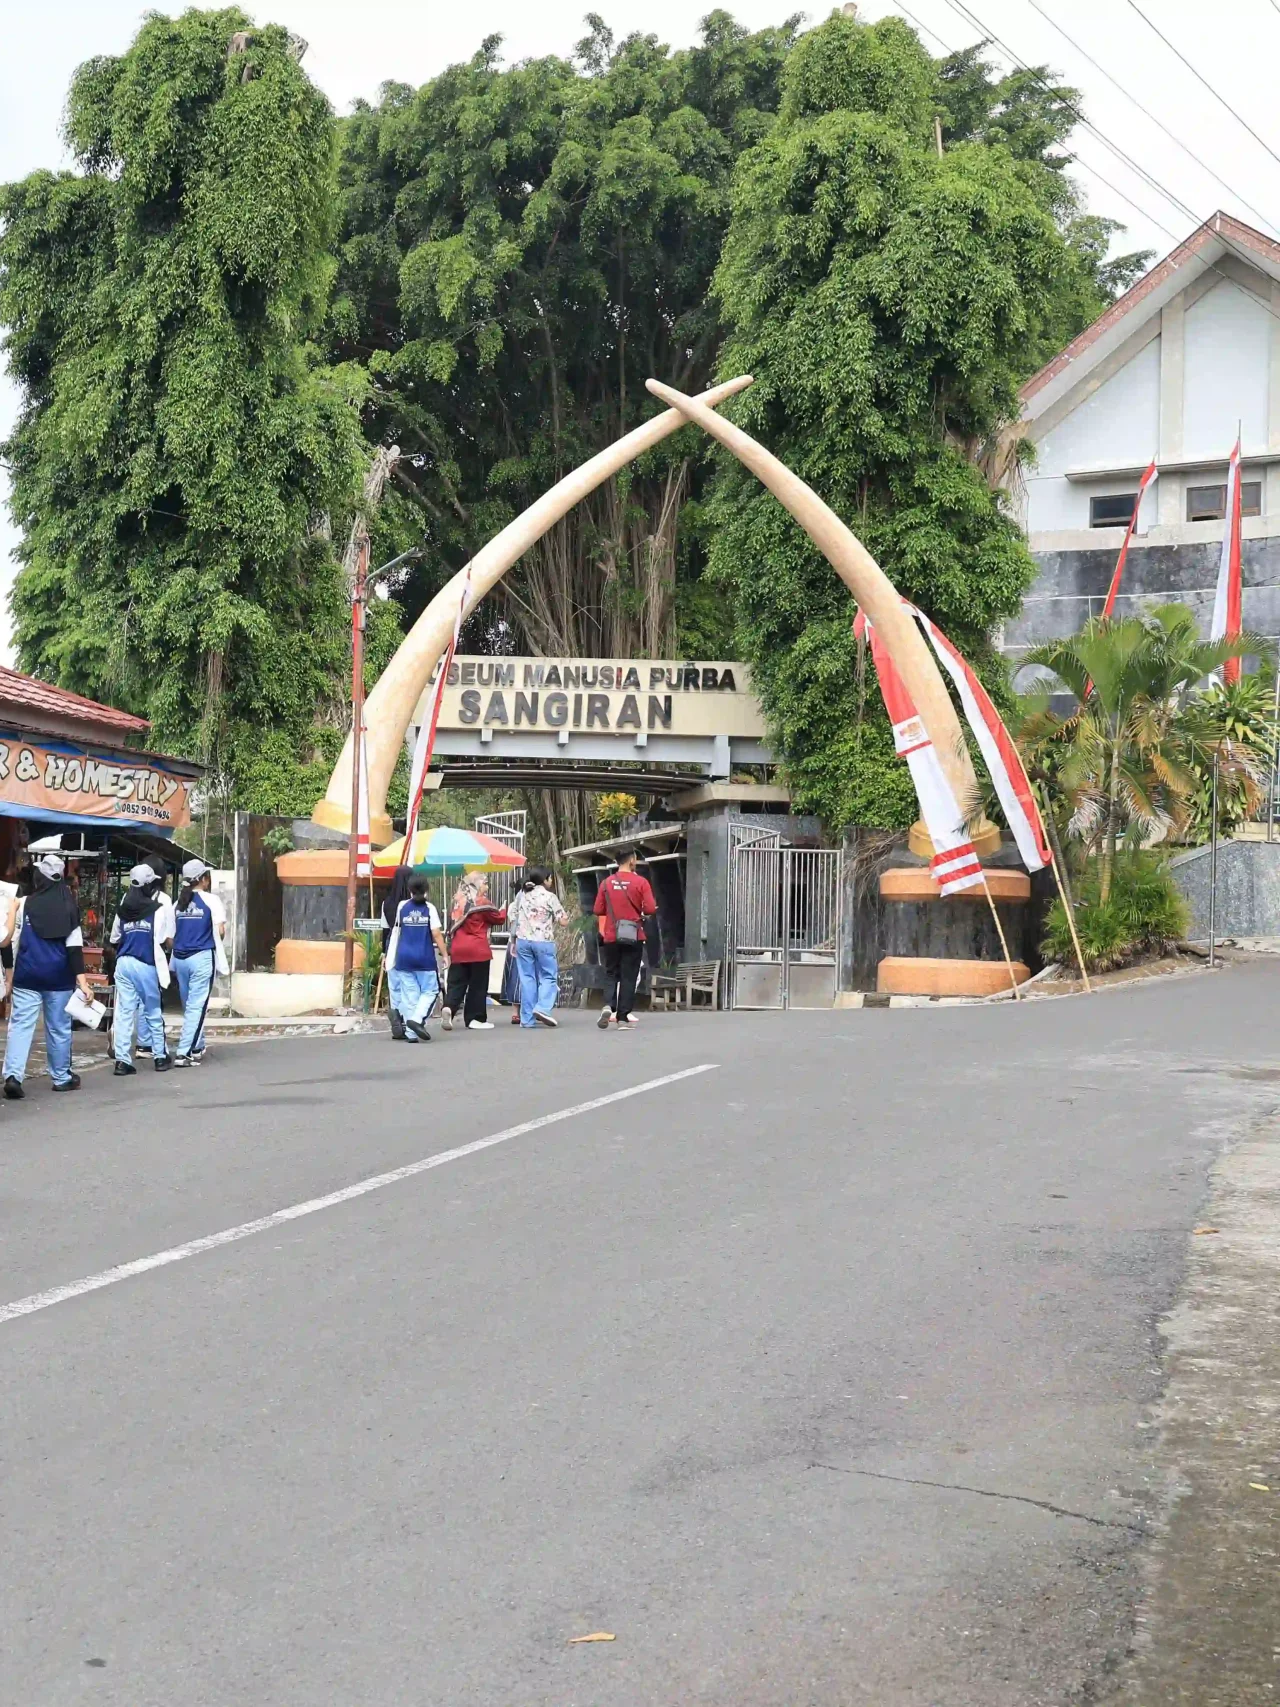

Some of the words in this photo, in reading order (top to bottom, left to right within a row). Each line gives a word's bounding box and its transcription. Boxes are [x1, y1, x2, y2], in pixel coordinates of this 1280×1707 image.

[523, 664, 641, 691] MANUSIA
[649, 667, 737, 692] PURBA
[458, 689, 672, 729] SANGIRAN
[15, 748, 40, 782] &
[44, 753, 178, 807] HOMESTAY
[121, 803, 139, 815] 0852
